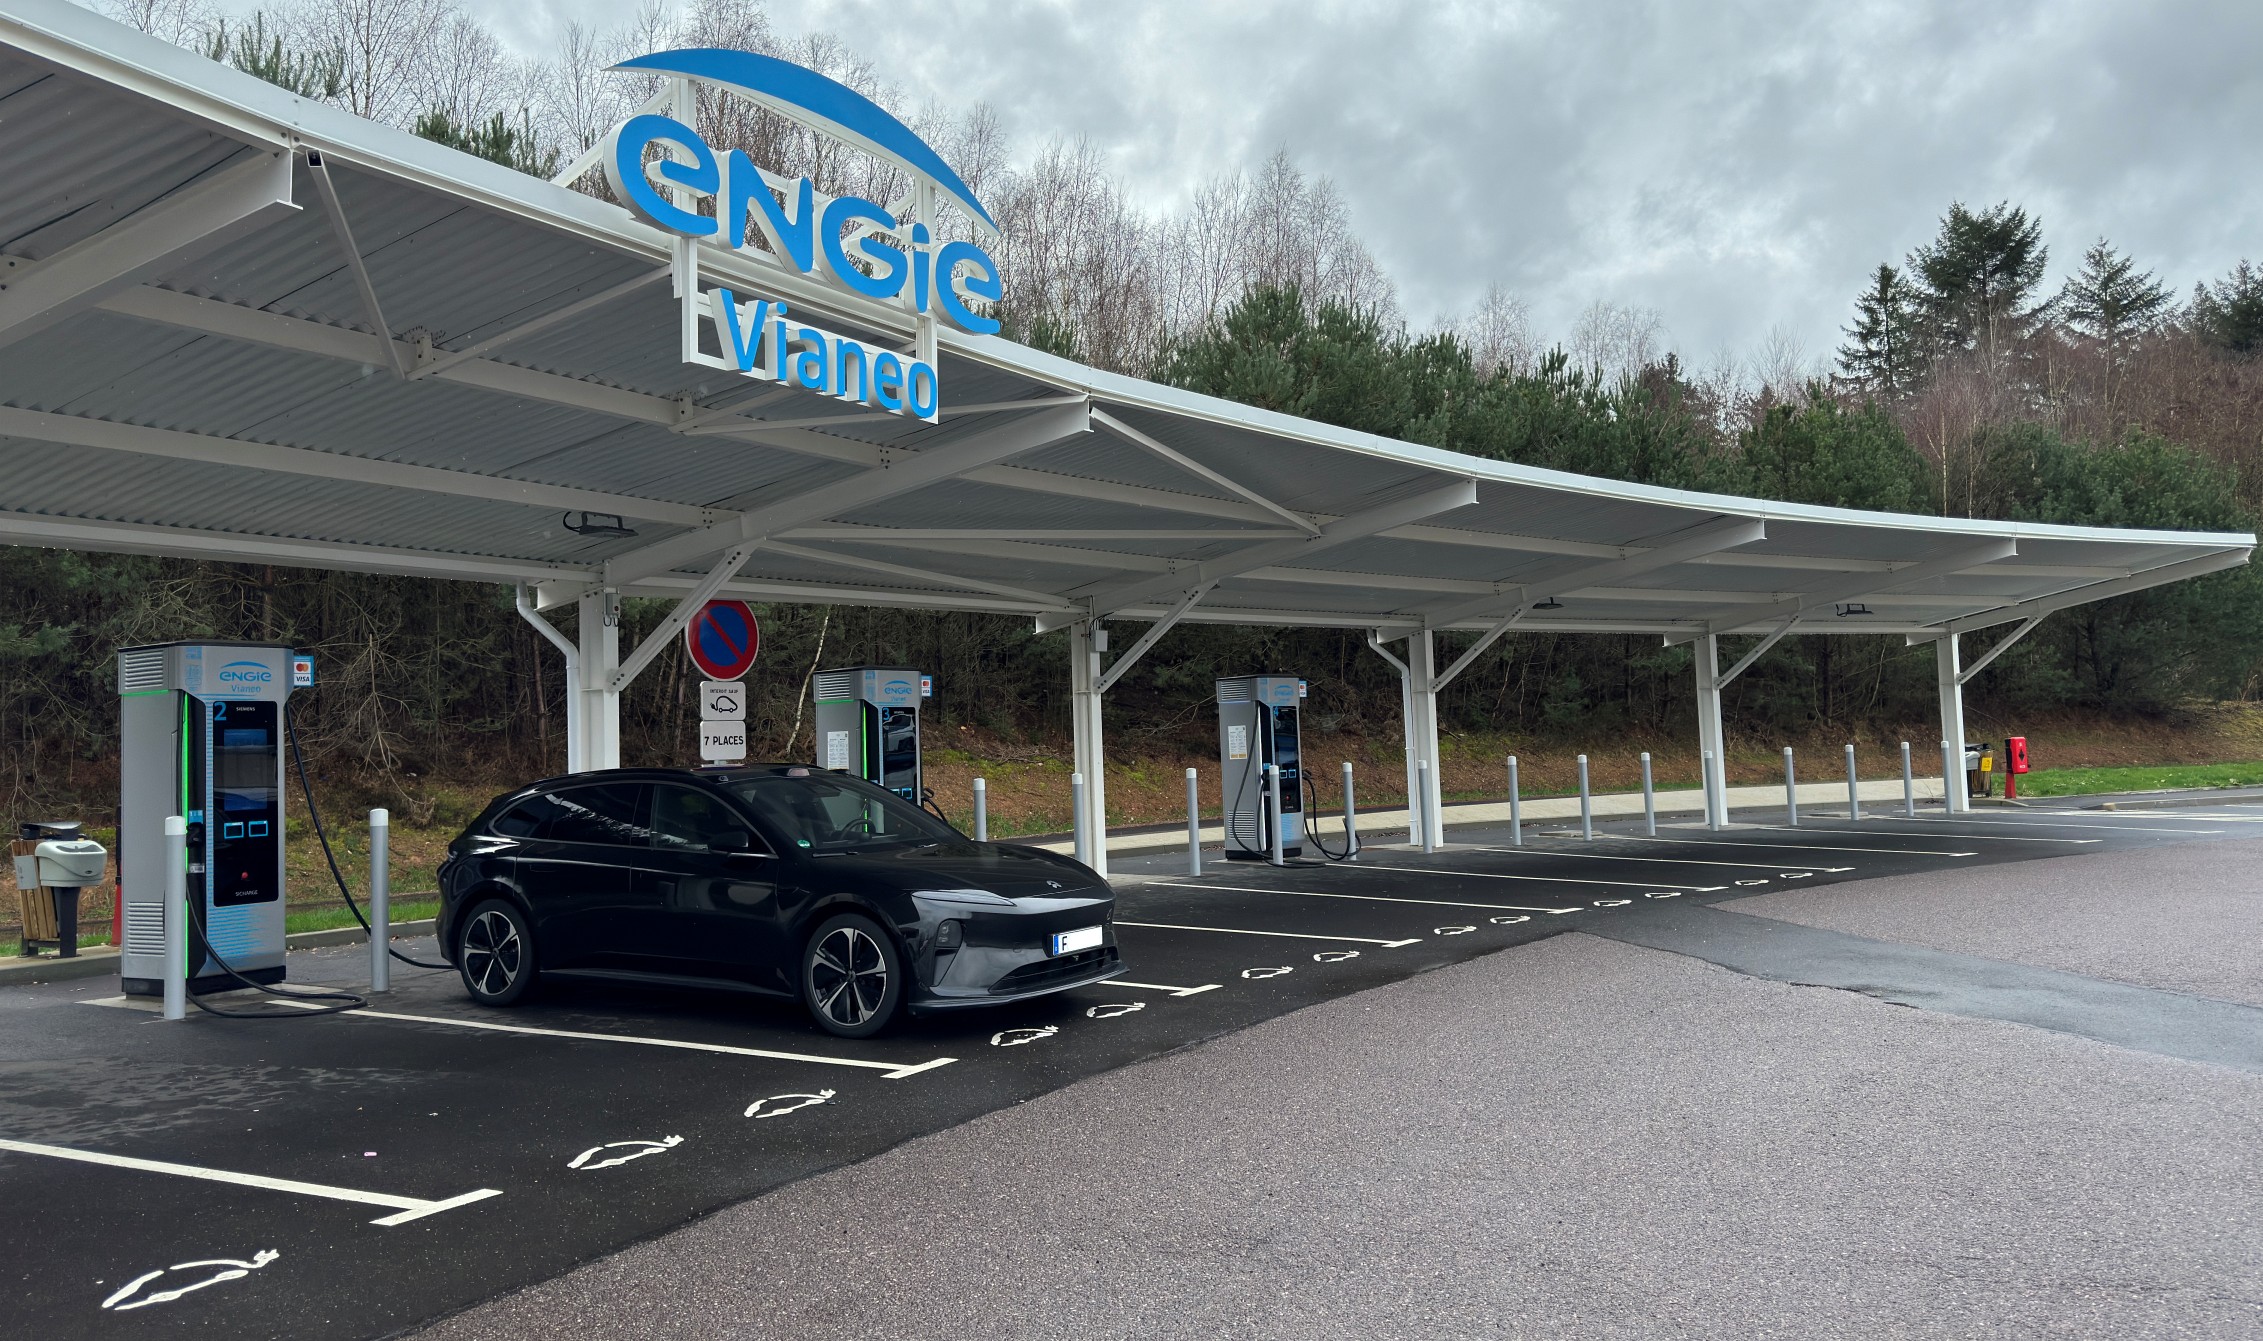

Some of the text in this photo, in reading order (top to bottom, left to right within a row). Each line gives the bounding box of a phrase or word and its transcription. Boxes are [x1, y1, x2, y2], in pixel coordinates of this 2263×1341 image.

[708, 288, 937, 419] Vianeo
[231, 684, 262, 693] Vianeo
[214, 702, 227, 721] 2
[882, 707, 890, 721] 3
[704, 735, 744, 746] 7 PLACES
